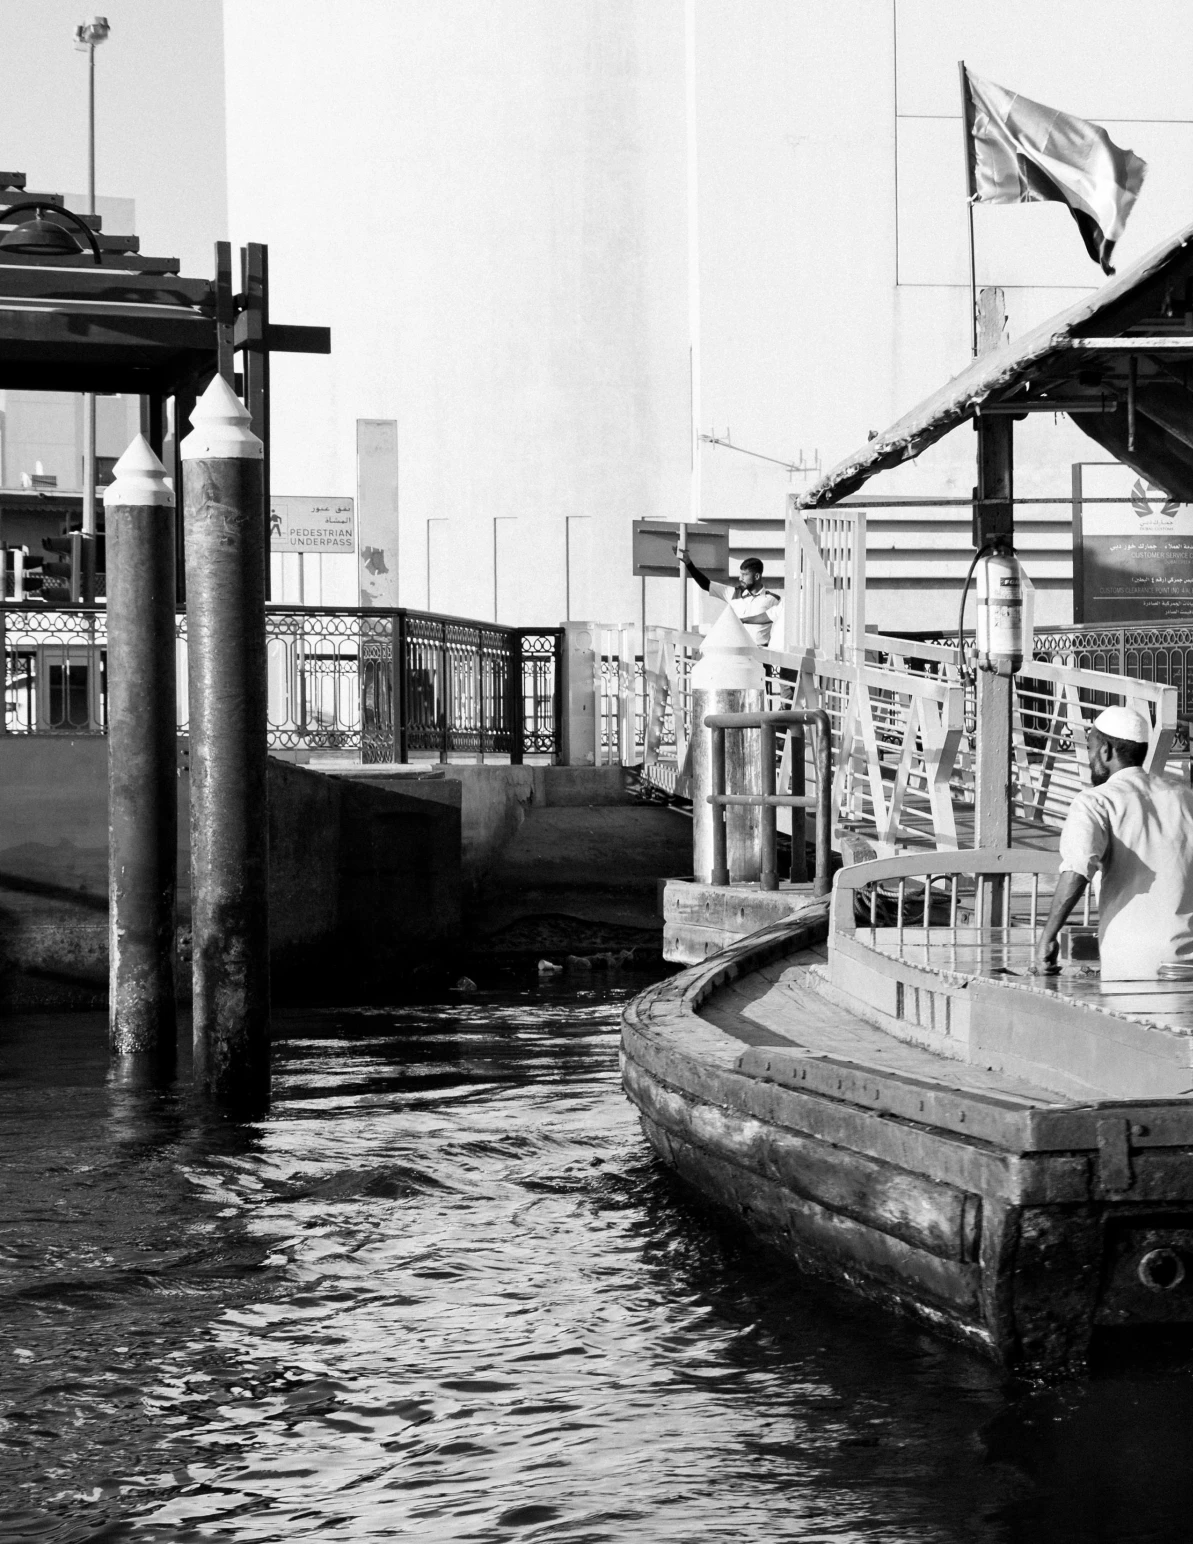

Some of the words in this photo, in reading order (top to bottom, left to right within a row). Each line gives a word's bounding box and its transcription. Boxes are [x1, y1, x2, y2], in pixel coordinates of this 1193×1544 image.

[290, 529, 352, 537] PEDESTRIAN
[290, 538, 352, 546] UNDERPASS
[1124, 543, 1136, 551] خور
